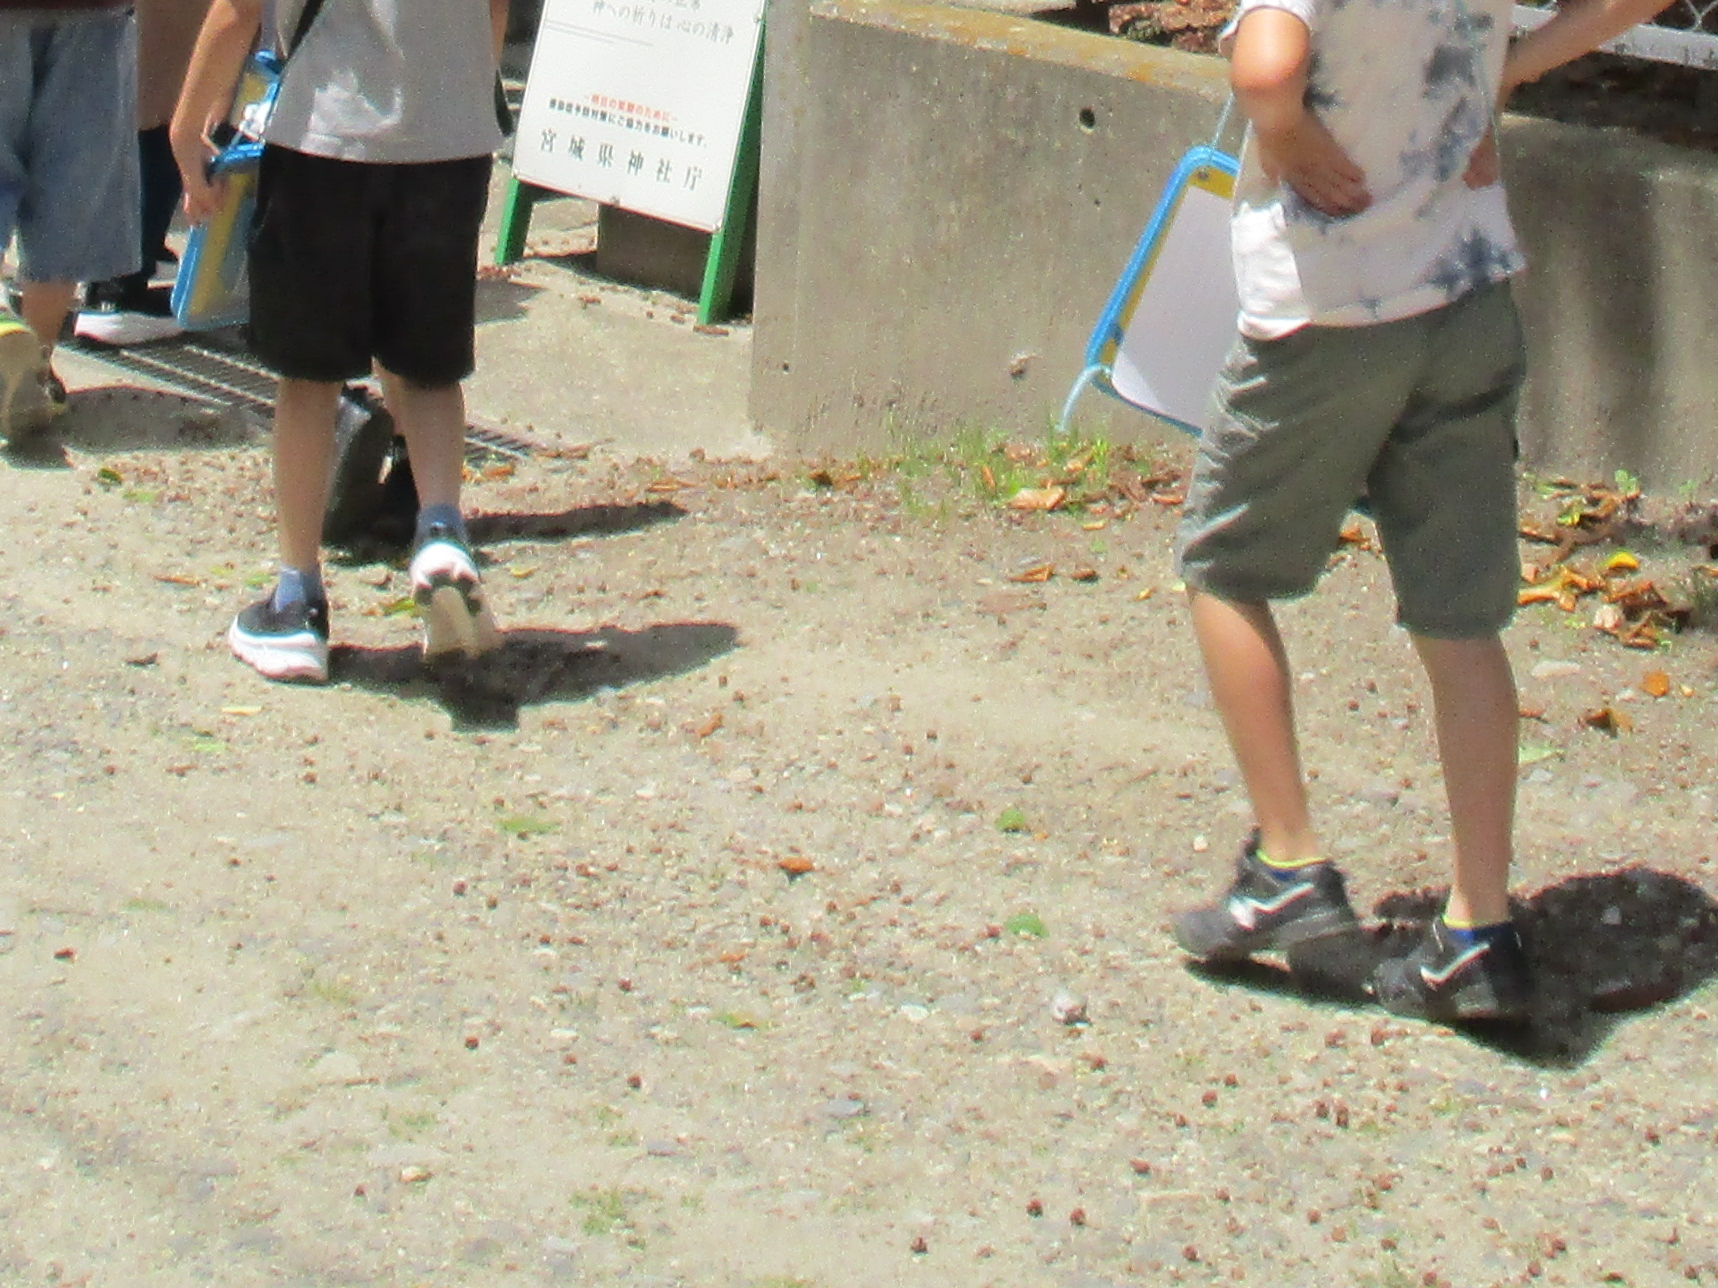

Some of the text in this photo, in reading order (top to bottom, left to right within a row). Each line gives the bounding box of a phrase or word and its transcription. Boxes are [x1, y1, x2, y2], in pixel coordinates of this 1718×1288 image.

[540, 128, 703, 190] 宮城県神社庁
